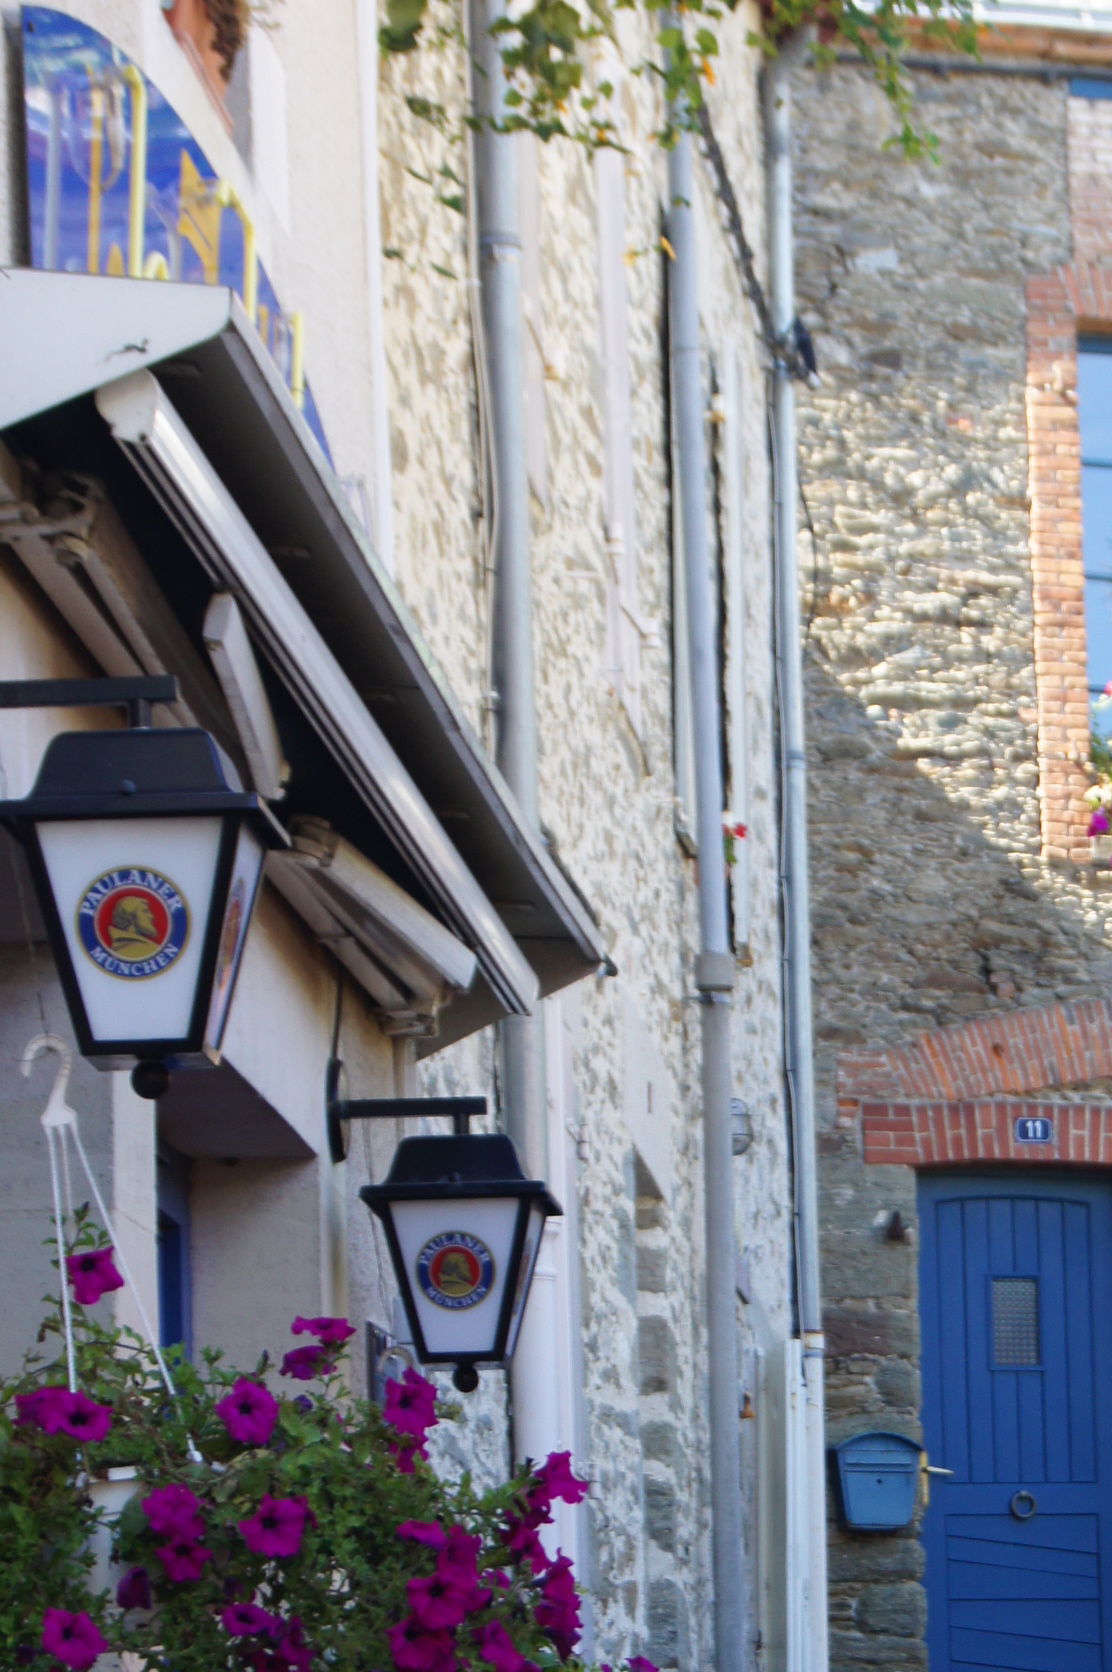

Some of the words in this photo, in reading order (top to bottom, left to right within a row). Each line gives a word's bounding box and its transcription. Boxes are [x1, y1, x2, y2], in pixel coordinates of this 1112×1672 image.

[81, 869, 182, 916] PAULANER
[1025, 1120, 1042, 1138] 11
[420, 1233, 490, 1264] PAULANER
